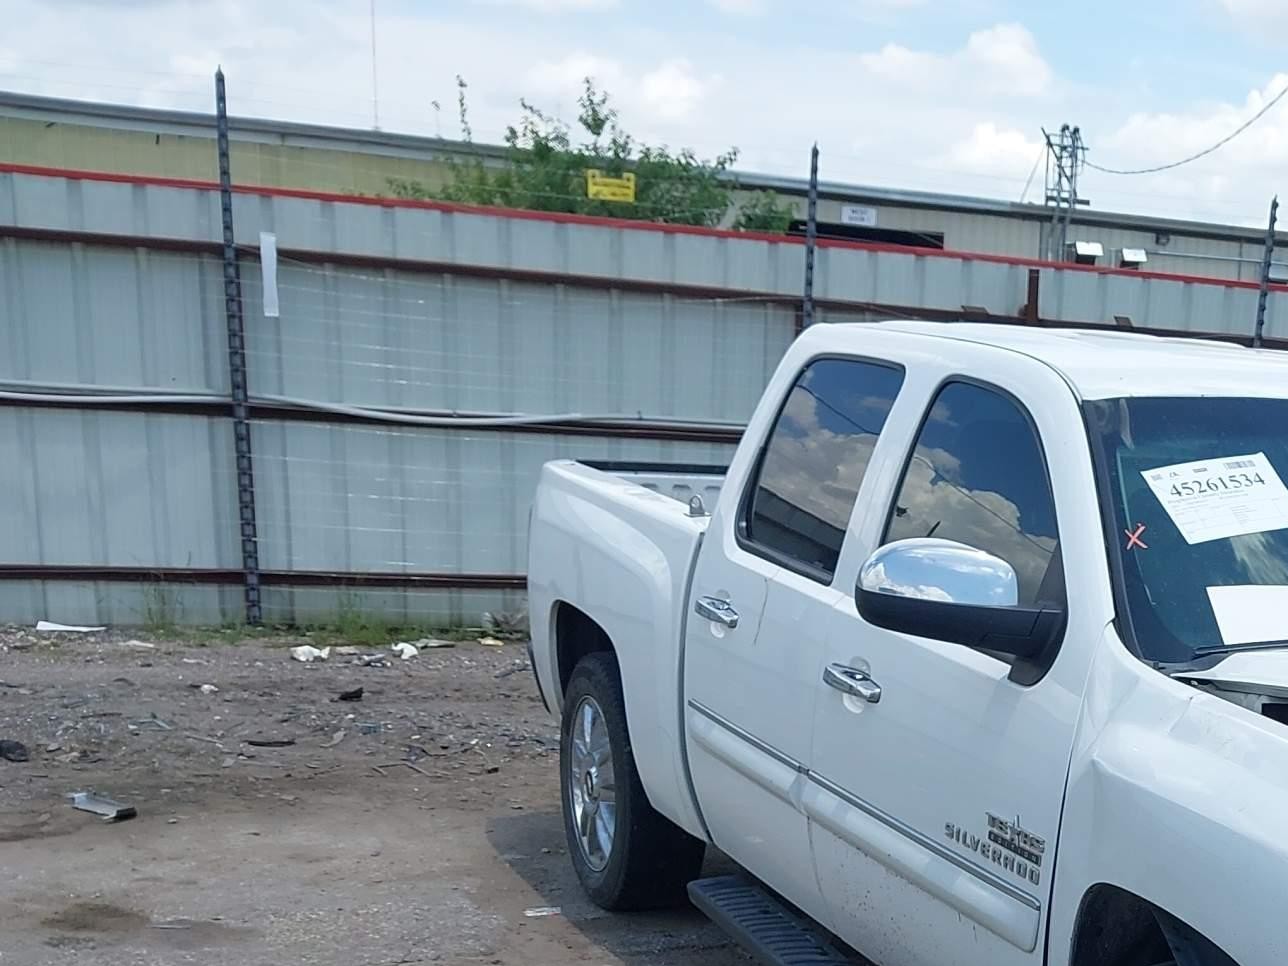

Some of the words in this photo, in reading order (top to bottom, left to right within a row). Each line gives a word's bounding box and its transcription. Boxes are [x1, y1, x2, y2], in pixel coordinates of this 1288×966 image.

[1169, 472, 1267, 497] 45261534
[944, 822, 1040, 886] SILVERADO
[985, 812, 1046, 854] TEXAS
